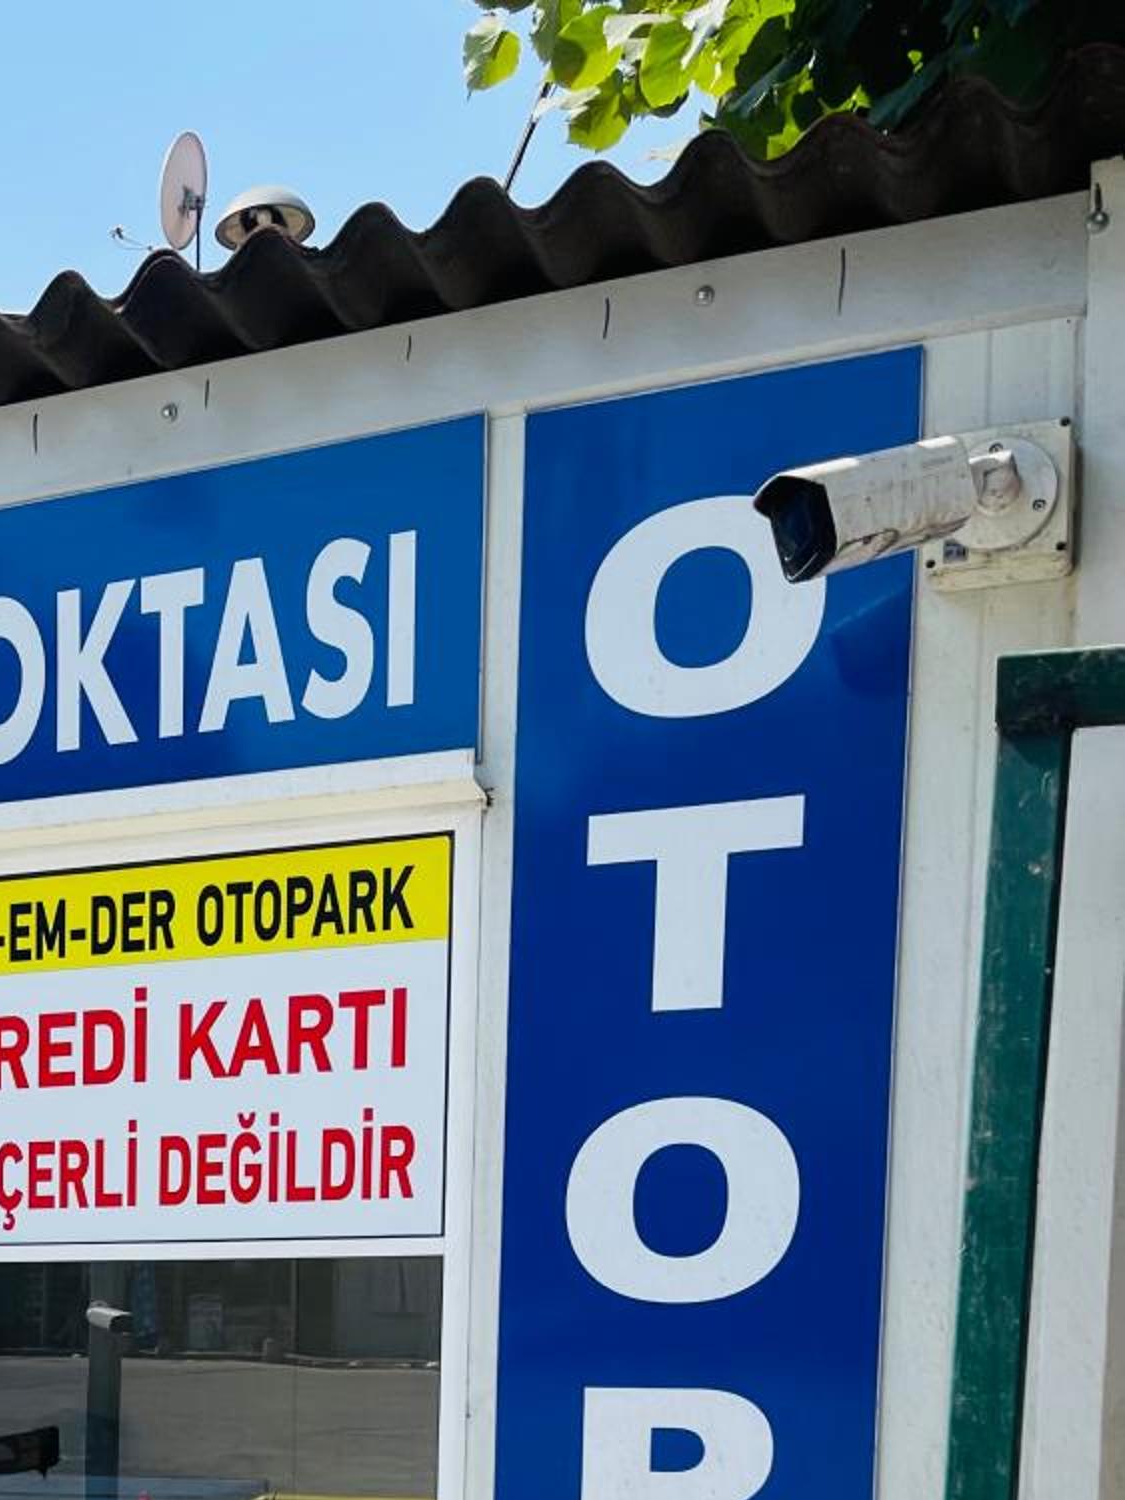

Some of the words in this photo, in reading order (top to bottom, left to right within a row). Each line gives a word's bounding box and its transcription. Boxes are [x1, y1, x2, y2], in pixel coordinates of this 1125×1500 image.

[196, 865, 415, 946] OTOPARK
[178, 987, 407, 1081] KARTI
[159, 1107, 416, 1206] DEĞİLDİR
